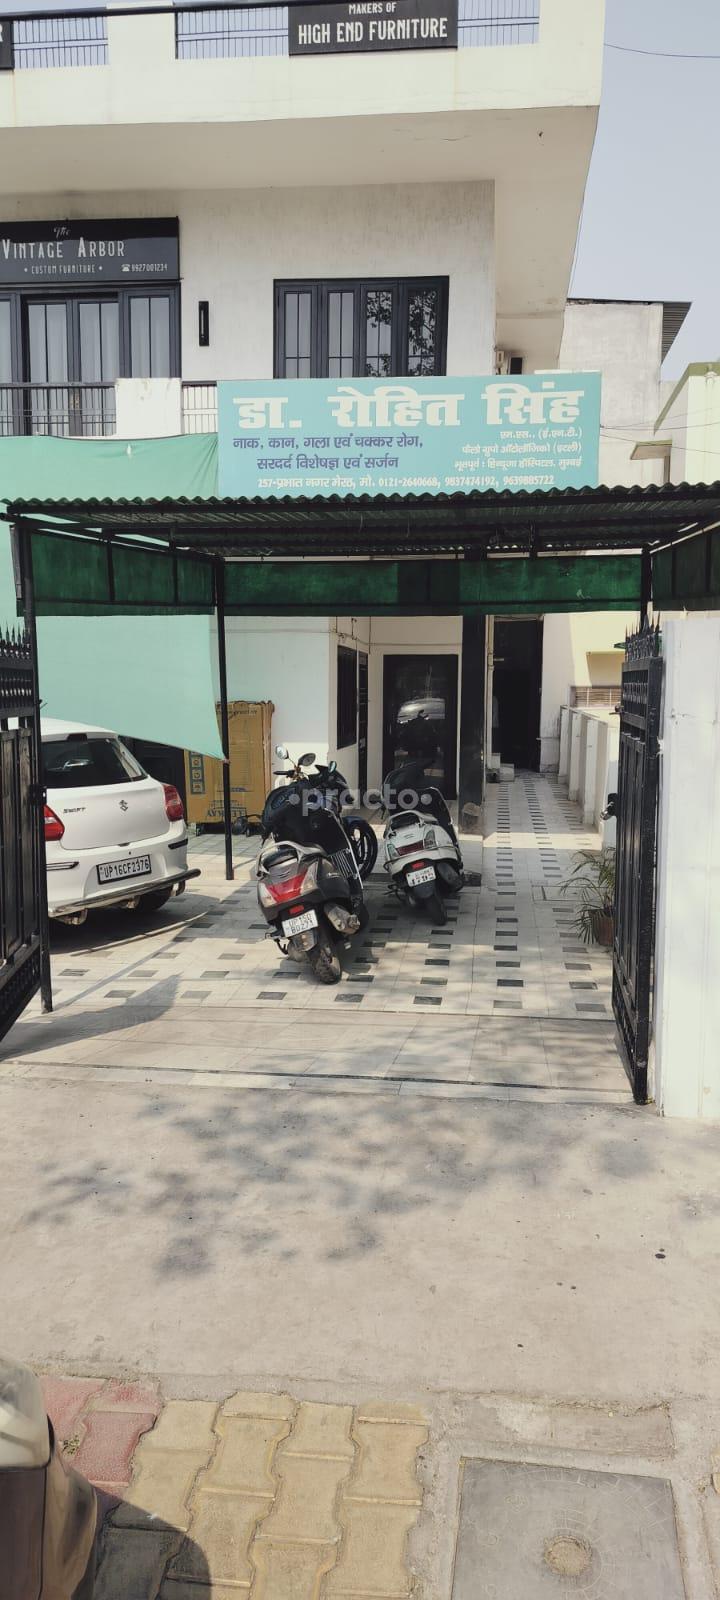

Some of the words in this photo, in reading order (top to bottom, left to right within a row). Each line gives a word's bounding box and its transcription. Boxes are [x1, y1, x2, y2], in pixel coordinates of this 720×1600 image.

[349, 3, 383, 15] MAKERS
[386, 2, 397, 13] OF
[298, 23, 331, 45] HIGH
[336, 22, 363, 43] END
[369, 17, 448, 41] FURNITURE
[31, 265, 57, 275] CUSTOM
[59, 264, 95, 274] FURNITURE
[232, 396, 302, 429] डा.
[327, 385, 465, 428] रोहित
[481, 381, 585, 426] सिंह
[233, 436, 264, 449] नाक,
[268, 436, 299, 449] कान,
[303, 436, 330, 448] गला
[334, 433, 354, 448] एवं
[355, 435, 393, 448] चक्कर
[396, 432, 423, 449] रोग,
[256, 453, 292, 470] सरदर्द
[296, 453, 339, 470] विशेषज्ञ
[344, 453, 363, 469] एवं
[364, 453, 399, 469] सर्जन
[305, 477, 330, 488] नगर
